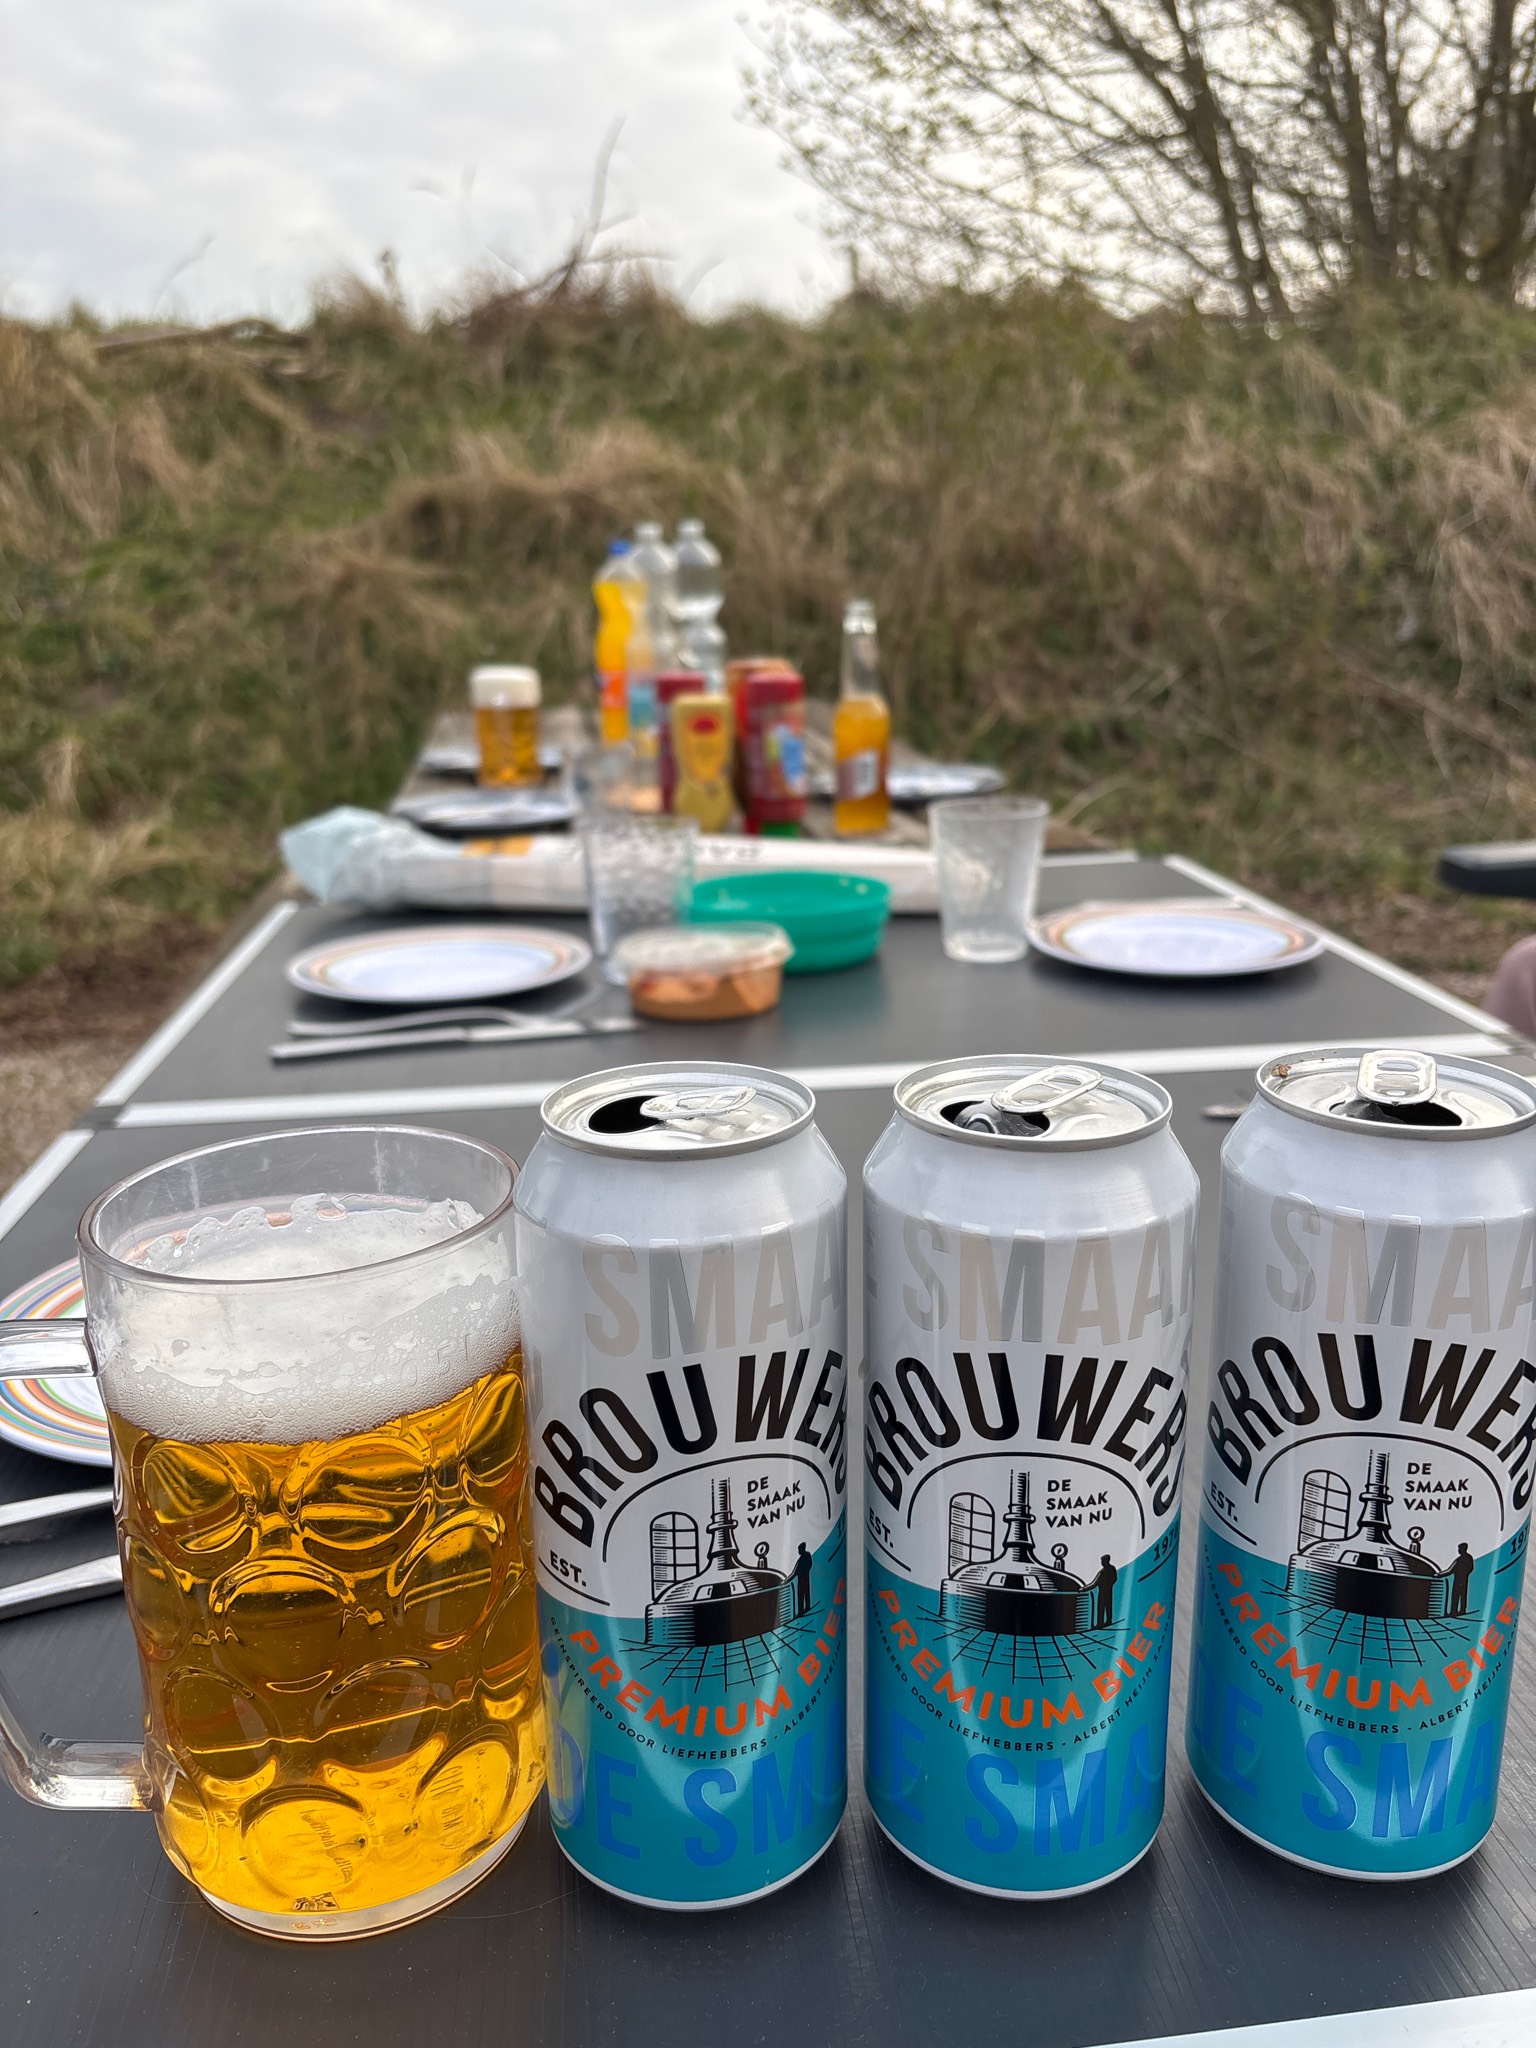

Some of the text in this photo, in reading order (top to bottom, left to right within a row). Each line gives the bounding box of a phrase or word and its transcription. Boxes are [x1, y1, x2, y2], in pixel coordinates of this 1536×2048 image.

[864, 1352, 1187, 1517] BROUWERS
[747, 1476, 770, 1495] DE
[1047, 1479, 1072, 1493] DE
[1405, 1479, 1469, 1494] SMAAK
[1407, 1462, 1432, 1476] DE
[746, 1480, 801, 1512] SMAAK
[747, 1495, 806, 1529] VAN NU
[1046, 1490, 1108, 1511] SMAAK
[1210, 1480, 1238, 1522] EST.
[1403, 1495, 1473, 1512] VAN NU
[868, 1507, 894, 1549] EST.
[1046, 1507, 1113, 1529] VAN NU
[550, 1548, 587, 1587] EST.
[1216, 1562, 1518, 1712] PREMIUM BIER
[878, 1589, 1168, 1730] PREMIUM BIER
[569, 1628, 793, 1738] PREMIUM
[1249, 1659, 1284, 1694] DOOR
[1289, 1694, 1400, 1735] LIEFHEBBERS
[1419, 1699, 1470, 1731] ALBERT
[1474, 1661, 1502, 1701] HEIJN
[617, 1720, 656, 1750] DOOR
[661, 1737, 768, 1761] LIEFHEBBERS
[783, 1690, 823, 1736] ALBERT
[911, 1686, 943, 1720] DOOR
[948, 1719, 1055, 1752] LIEFHEBBERS
[1073, 1708, 1121, 1745] ALBERT
[1125, 1666, 1153, 1708] HEIJN
